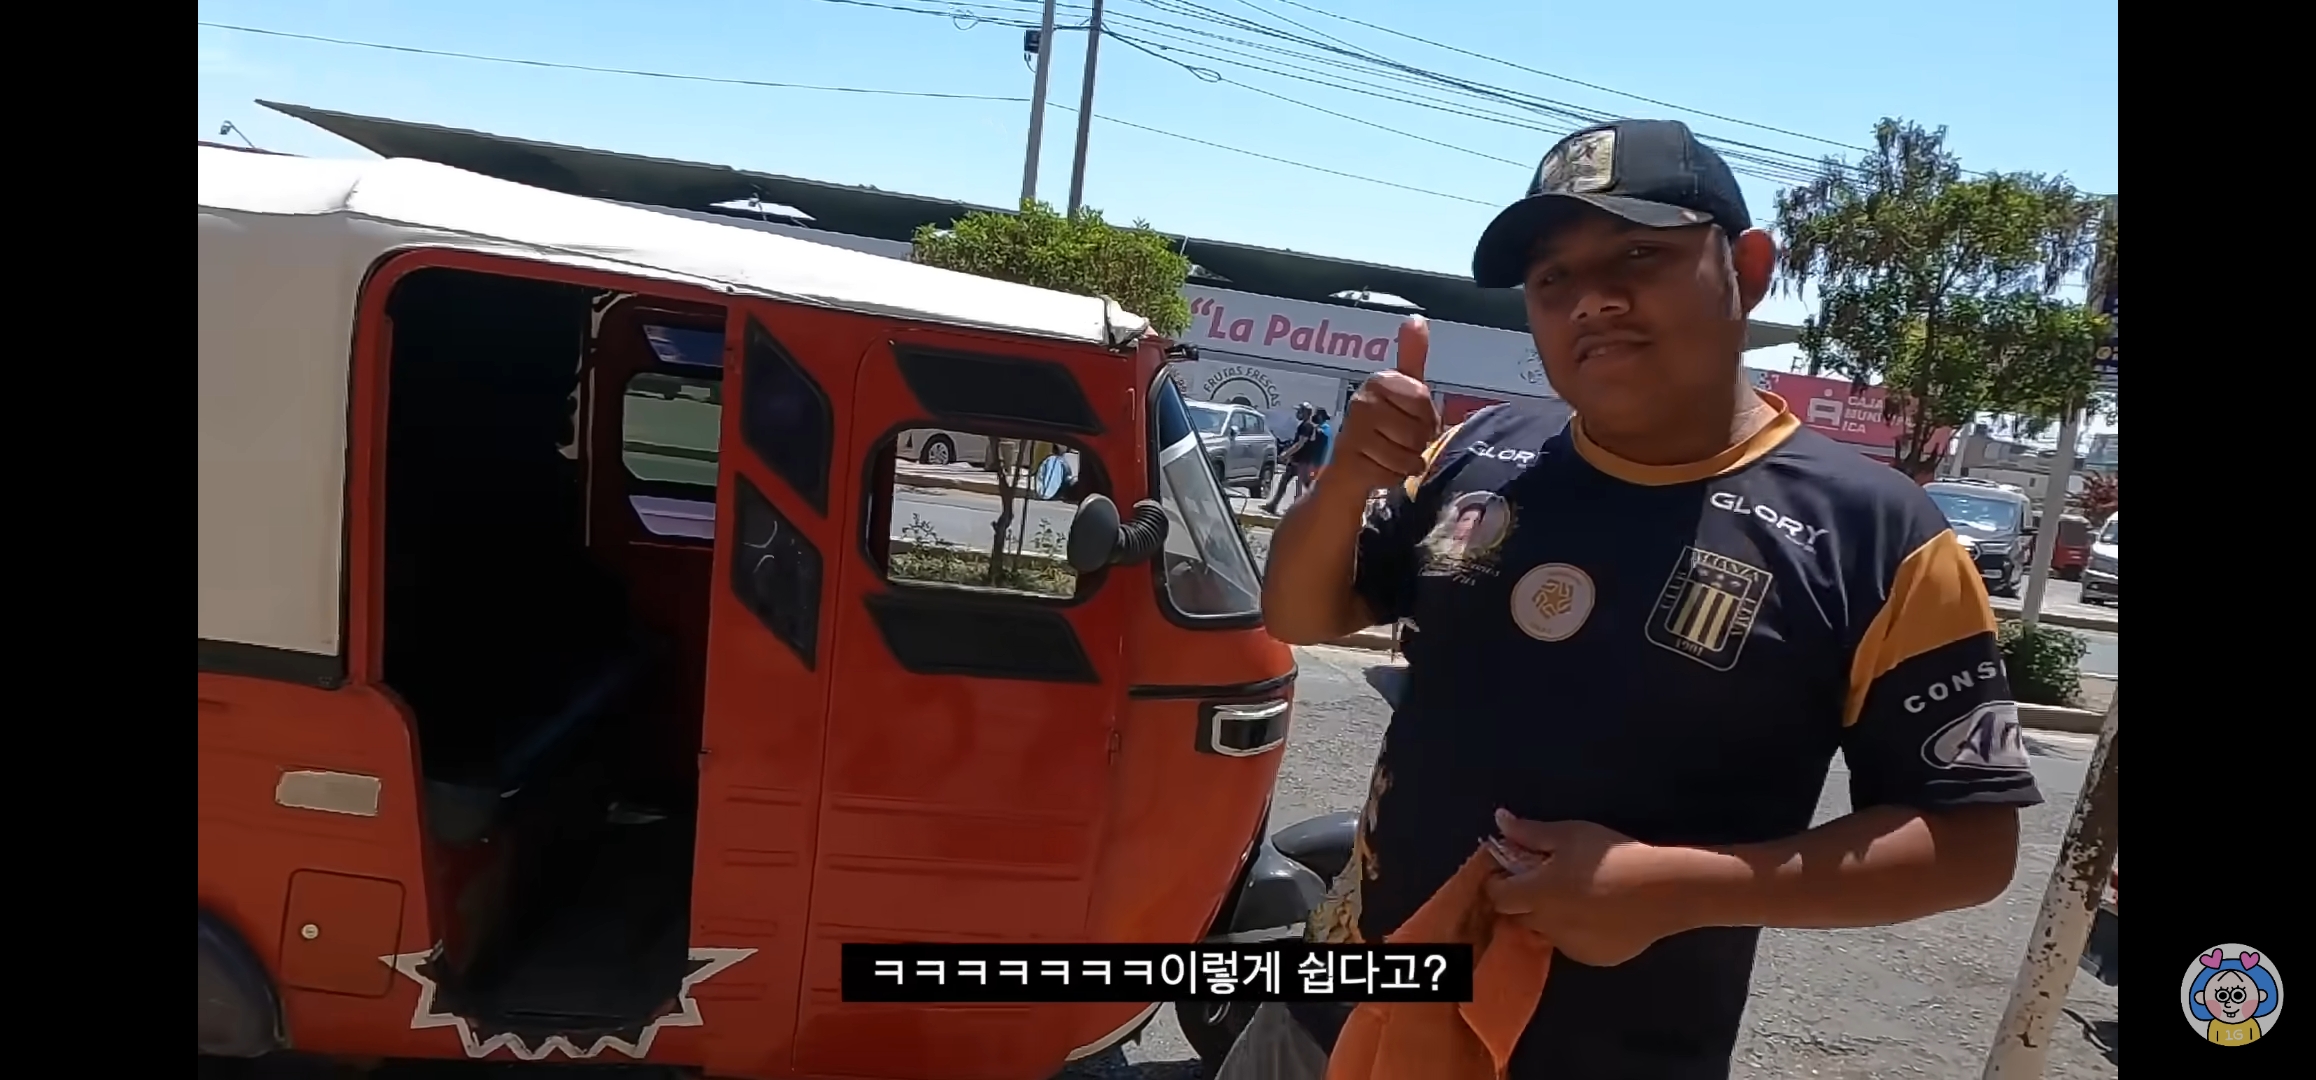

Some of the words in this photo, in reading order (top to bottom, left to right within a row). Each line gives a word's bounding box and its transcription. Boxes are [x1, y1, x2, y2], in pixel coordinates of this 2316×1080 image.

[1203, 366, 1243, 393] FRUTAS
[1245, 367, 1281, 407] FRESCAS
[1848, 396, 1883, 409] CAJA
[1842, 421, 1866, 434] ICA
[1709, 491, 1830, 543] GLORY
